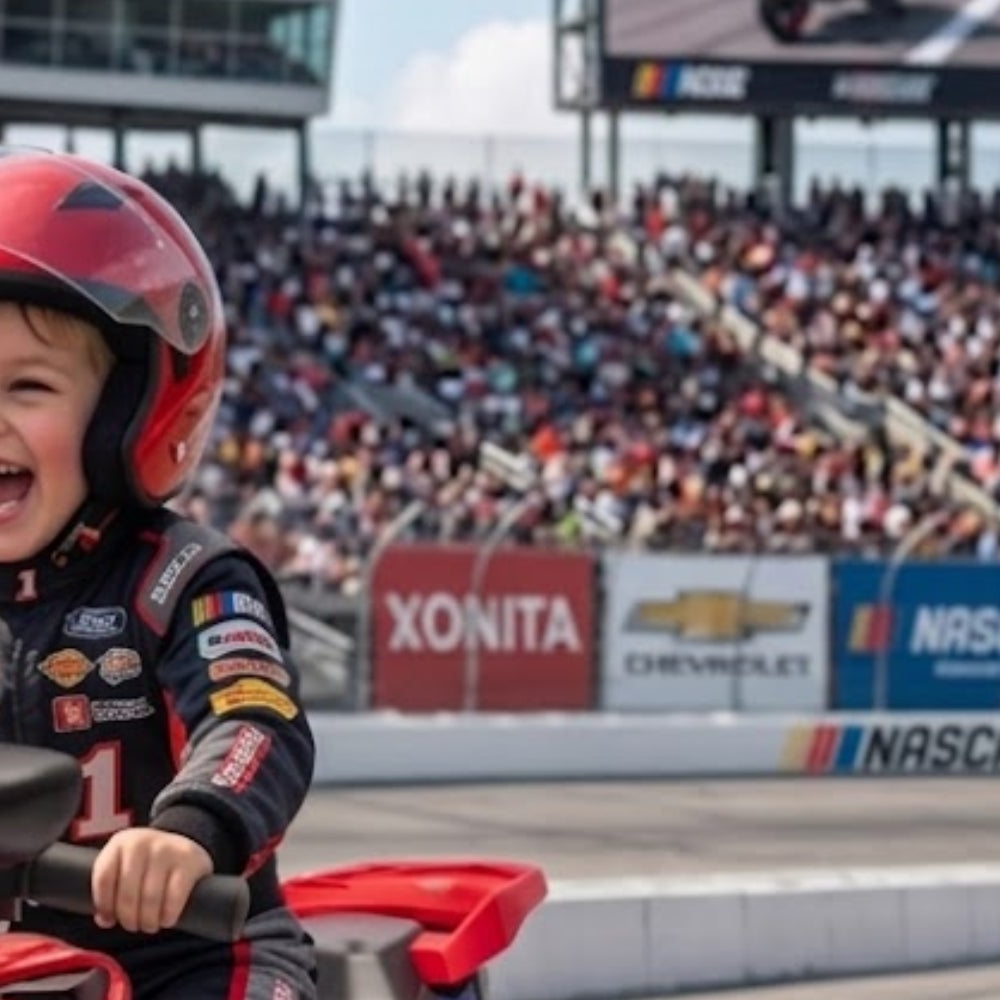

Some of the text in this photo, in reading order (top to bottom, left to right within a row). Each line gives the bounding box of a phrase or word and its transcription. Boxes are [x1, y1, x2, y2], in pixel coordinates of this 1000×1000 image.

[14, 569, 37, 602] 1
[386, 594, 580, 653] XONITA
[862, 722, 1000, 771] NASC
[74, 742, 134, 841] 1
